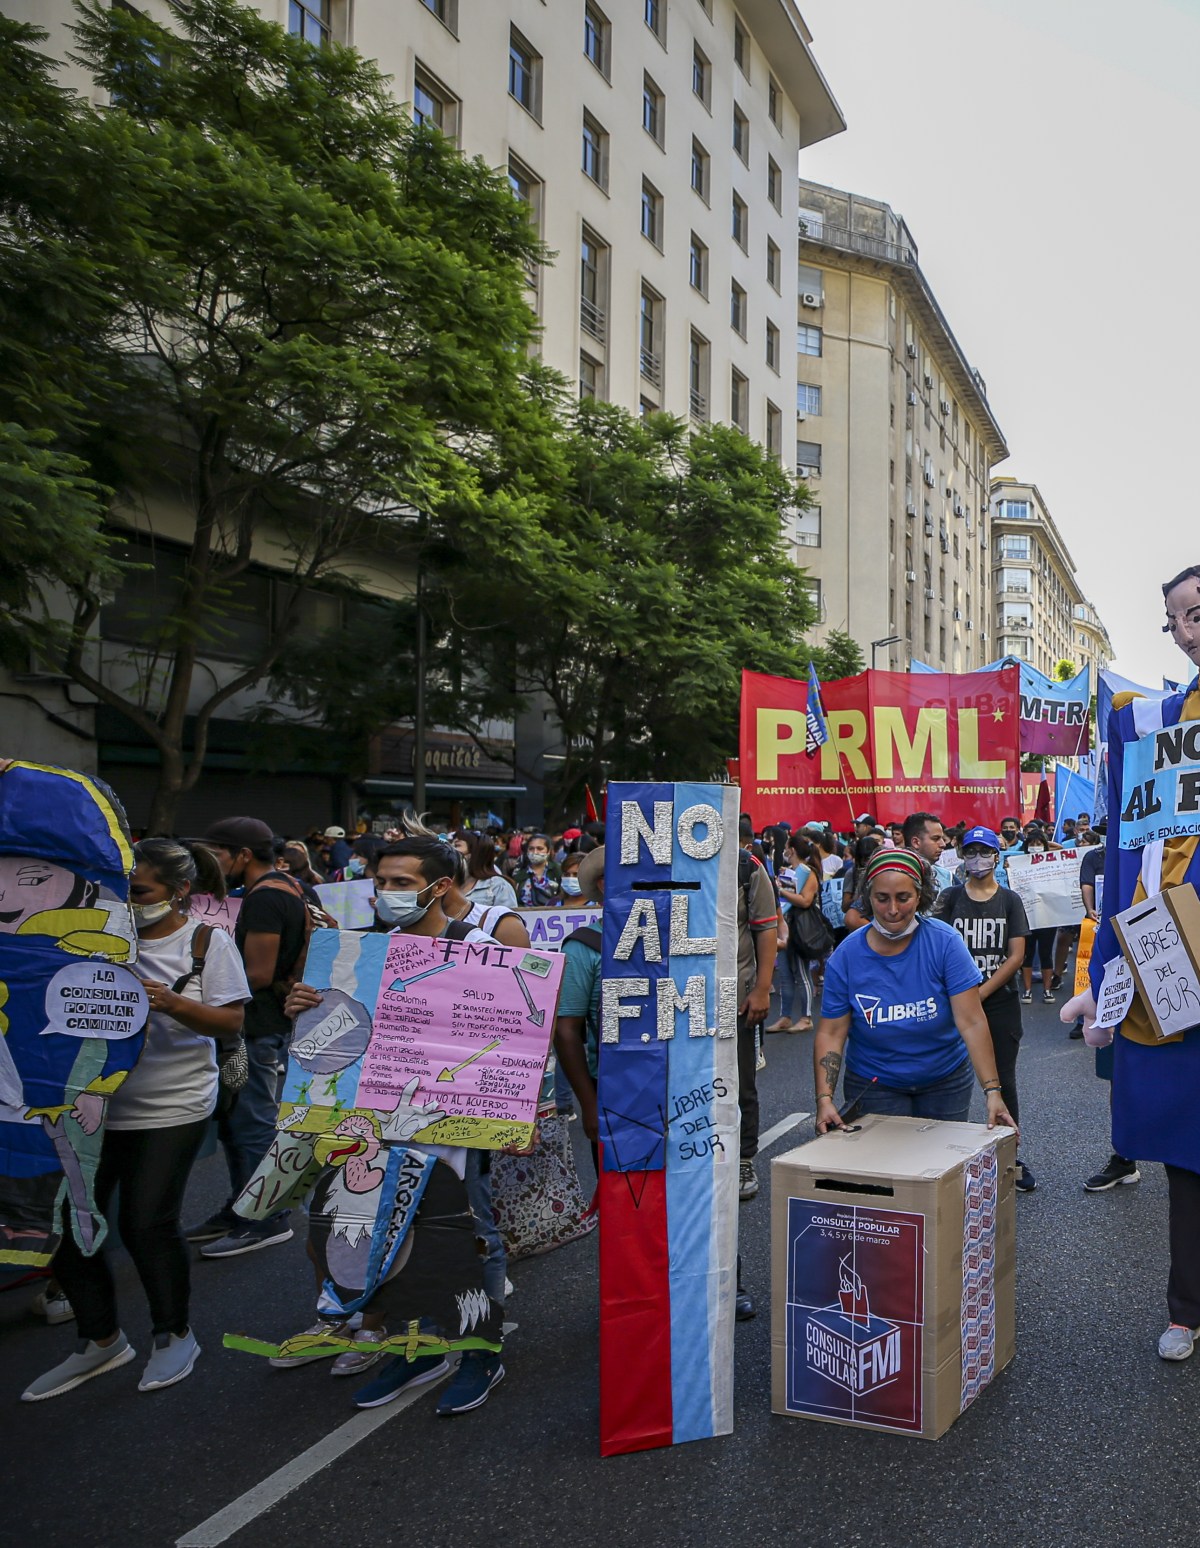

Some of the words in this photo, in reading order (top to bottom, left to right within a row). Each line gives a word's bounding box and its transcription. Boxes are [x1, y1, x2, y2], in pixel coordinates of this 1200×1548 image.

[756, 706, 1006, 780] PRML
[412, 746, 480, 772] oquito's
[808, 785, 891, 794] REVOLUCIONARIO
[895, 785, 951, 793] MARXISTA
[1121, 779, 1161, 822] AL
[619, 800, 723, 864] NO
[613, 895, 717, 962] AL
[387, 949, 424, 963] EXTERNA
[390, 943, 418, 955] DEUDA
[437, 940, 513, 969] FMI
[1129, 922, 1180, 966] LIBRES
[385, 959, 412, 970] DEUDA
[1154, 962, 1176, 982] DEL
[60, 987, 139, 1003] CONSULTA
[462, 989, 494, 1001] SALUD
[1156, 977, 1200, 1020] SUR
[64, 1002, 135, 1017] POPULAR
[877, 997, 938, 1023] LIBRES
[66, 1018, 131, 1032] CAMINA!
[297, 1010, 355, 1058] DEUDA
[436, 1094, 448, 1104] NO
[451, 1095, 462, 1106] AL
[466, 1097, 508, 1110] ACUERDO
[449, 1108, 463, 1116] CON
[467, 1108, 478, 1116] EL
[482, 1109, 517, 1120] FONDO
[384, 1113, 419, 1137] NO
[680, 1116, 717, 1135] DEL
[679, 1134, 724, 1160] SUR
[811, 1215, 856, 1229] CONSULTA
[858, 1221, 900, 1235] POPULAR
[820, 1229, 826, 1237] 3,
[827, 1230, 834, 1239] 4,
[835, 1231, 841, 1239] 5
[841, 1233, 847, 1241] y
[847, 1233, 853, 1241] 6
[855, 1234, 865, 1242] de
[866, 1236, 890, 1246] marzo
[806, 1322, 857, 1368] CONSULTA
[806, 1342, 857, 1389] POPULAR
[858, 1331, 900, 1391] FMI
